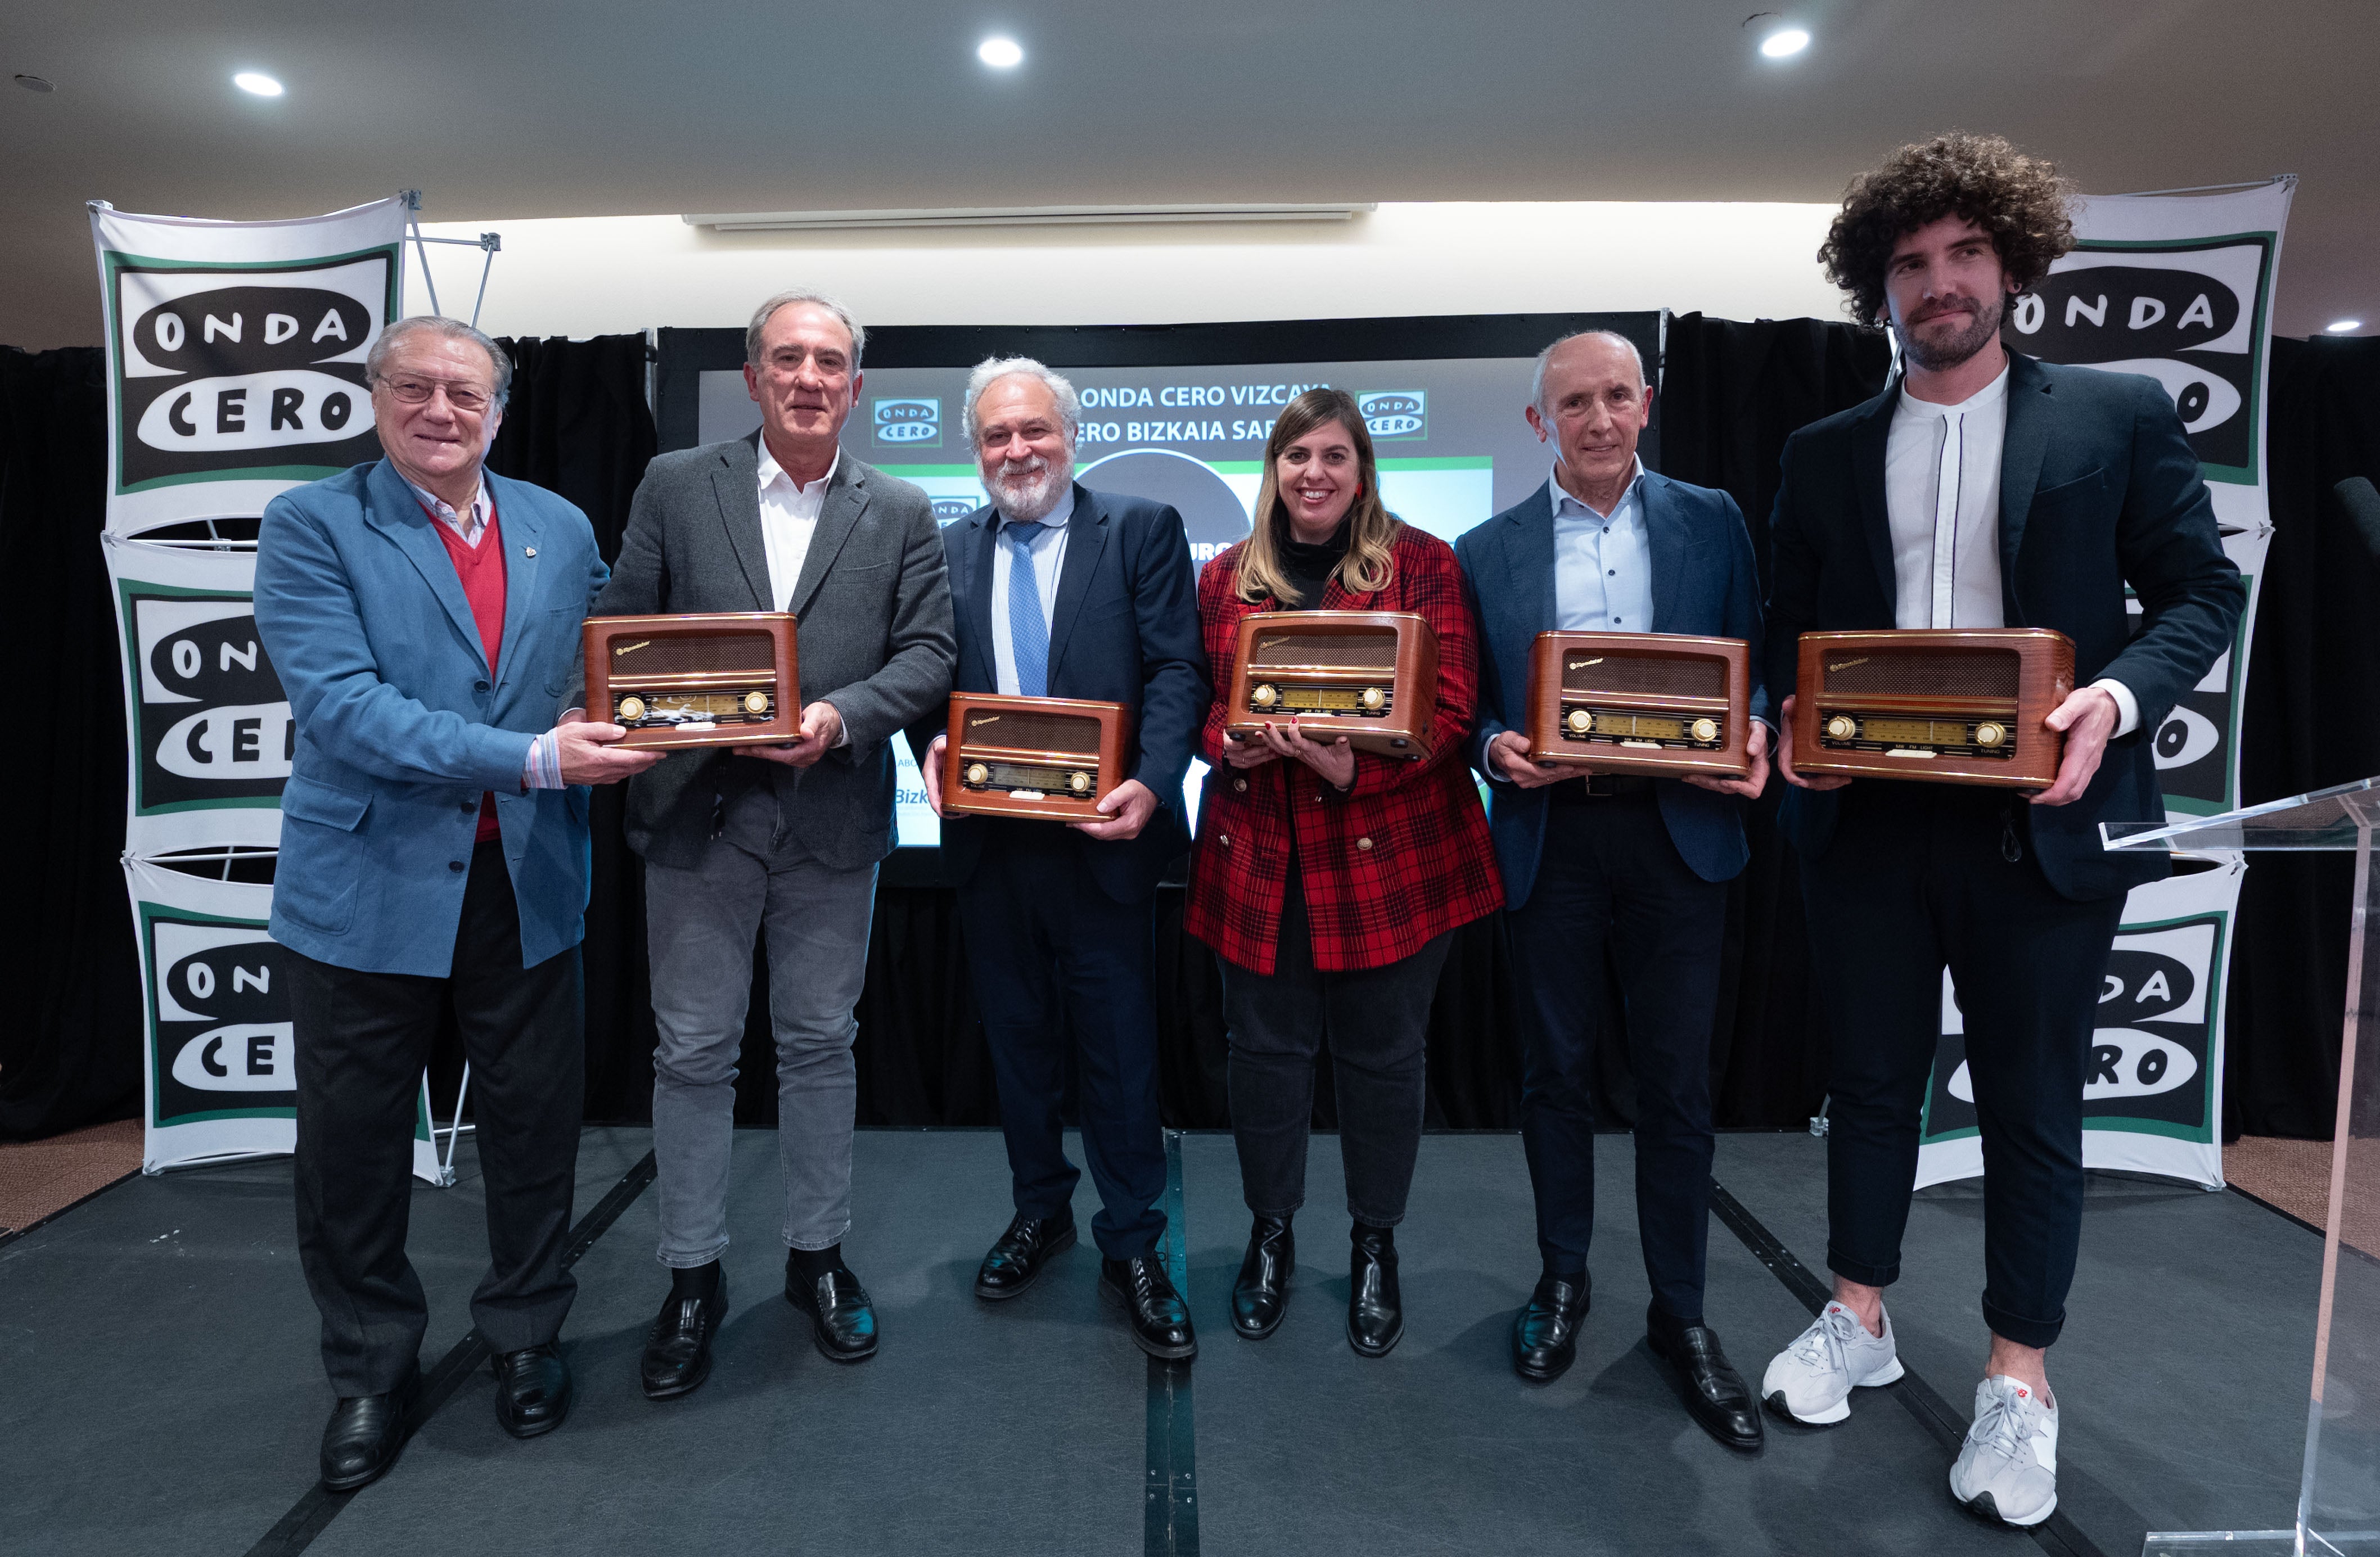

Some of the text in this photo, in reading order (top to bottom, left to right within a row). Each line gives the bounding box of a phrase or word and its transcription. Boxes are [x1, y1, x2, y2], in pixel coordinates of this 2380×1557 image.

[155, 308, 348, 351] ONDA
[2013, 292, 2214, 334] ONDA
[169, 387, 351, 436] CERO
[883, 408, 929, 419] ONDA
[1080, 383, 1331, 408] ONDA CERO VIZCA
[1367, 400, 1415, 412] ONDA
[886, 426, 930, 437] CERO
[1075, 422, 1121, 442] ERO
[1126, 420, 1226, 442] BIZKAIA
[1370, 419, 1415, 431] CERO
[932, 506, 969, 515] NDA
[172, 640, 258, 679] ON
[186, 717, 295, 765] CE
[187, 962, 270, 999] ON
[201, 1036, 275, 1077] CE
[2086, 1044, 2168, 1086] RO
